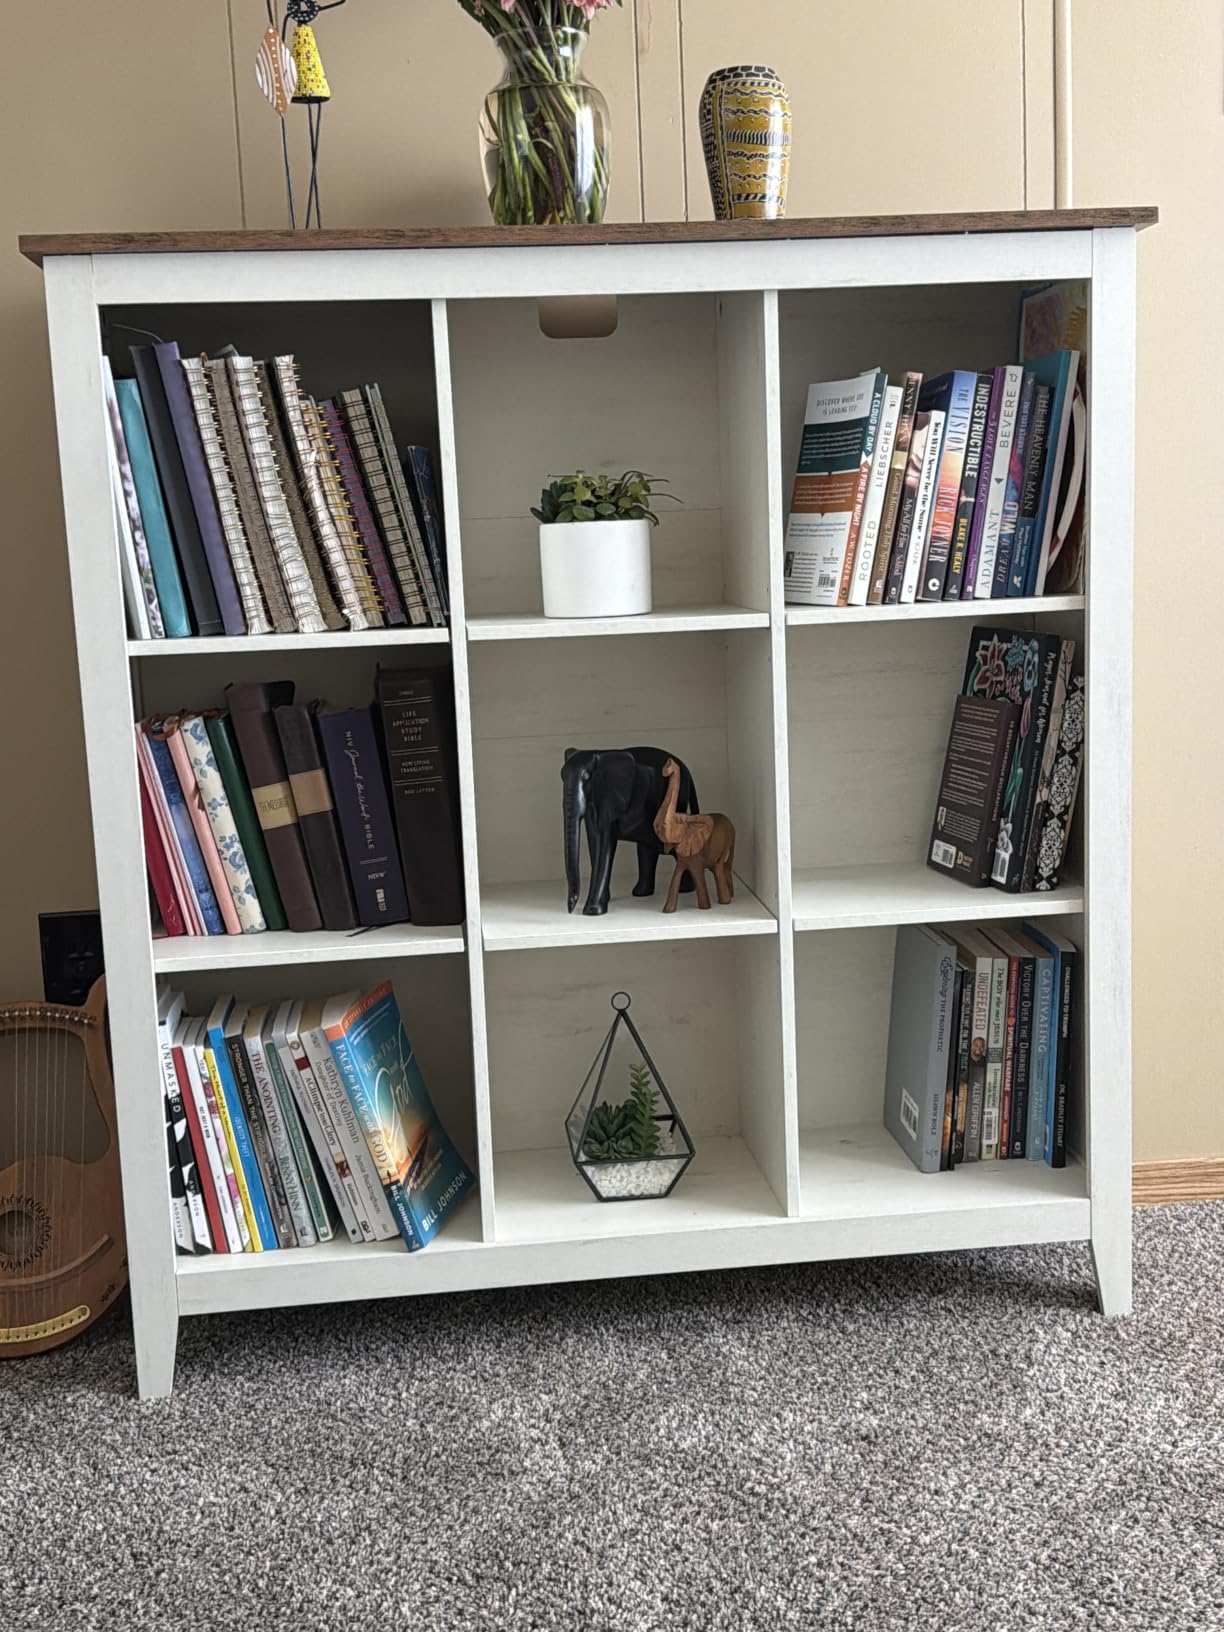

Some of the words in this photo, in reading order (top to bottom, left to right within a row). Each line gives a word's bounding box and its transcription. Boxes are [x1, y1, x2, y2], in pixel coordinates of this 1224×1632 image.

[957, 388, 969, 402] THE
[1037, 394, 1050, 416] THE
[869, 399, 881, 425] CLOUD
[999, 390, 1017, 448] BEVERE
[865, 436, 874, 452] DAY
[867, 425, 876, 436] BY
[933, 421, 942, 437] You
[945, 406, 970, 454] VISION
[965, 383, 990, 478] INDESTRUCTIBLE
[985, 428, 995, 450] LOVE
[875, 421, 893, 488] LIEBSCHER
[930, 437, 939, 456] Will
[1028, 419, 1047, 477] HEAVENLY
[858, 473, 868, 491] FIRE
[926, 457, 935, 480] Never
[978, 453, 992, 503] LANGUAGES
[856, 491, 865, 501] BY
[921, 490, 929, 508] the
[923, 481, 931, 490] be
[935, 487, 957, 513] RICK
[1024, 481, 1036, 510] MAN
[852, 501, 863, 526] NIGHT
[902, 512, 912, 524] All
[904, 499, 913, 512] My
[917, 510, 926, 532] Same
[999, 501, 1019, 535] WILD
[897, 533, 908, 548] Him
[928, 520, 954, 562] JOYNER
[956, 518, 968, 541] BLAKE
[859, 520, 876, 581] ROOTED
[952, 551, 963, 574] HEALY
[980, 509, 1000, 589] ADAMANT
[996, 538, 1010, 583] DREAM
[392, 718, 429, 727] APPLICATION
[402, 710, 416, 718] LIFE
[401, 727, 422, 735] STUDY
[1001, 729, 1013, 776] BREAKTHROUGH
[991, 777, 1004, 821] DECLARATIONS
[364, 823, 375, 850] BIBLE
[1022, 964, 1033, 998] VICTORY
[1063, 966, 1072, 1004] CHALLENGED
[939, 1000, 948, 1013] THE
[974, 972, 990, 1031] UNDEFEATED
[1021, 1000, 1032, 1021] OVER
[1038, 967, 1051, 1053] CAPTIVATING
[937, 1014, 946, 1053] PROPHETIC
[992, 1021, 1001, 1045] JESUS
[1005, 1026, 1014, 1059] SPIRITUAL
[1020, 1024, 1028, 1038] THE
[161, 1043, 181, 1113] UNMASKED
[1004, 1060, 1012, 1091] WARFARE
[1017, 1041, 1029, 1083] DARKNESS
[231, 1043, 247, 1083] STRONGER
[243, 1084, 253, 1104] THAN
[249, 1105, 257, 1120] THE
[253, 1121, 268, 1159] STRUGGLE
[252, 1050, 264, 1073] THE
[259, 1076, 280, 1134] ANOINTING
[315, 1061, 331, 1090] Daughter
[326, 1091, 333, 1101] of
[330, 1101, 343, 1127] Destiny
[323, 1058, 343, 1097] Kathryn
[339, 1098, 359, 1144] Kuhlman
[336, 1044, 353, 1074] FACE
[348, 1074, 356, 1083] to
[352, 1085, 368, 1113] FACE
[364, 1115, 378, 1133] with
[371, 1135, 388, 1163] GOD
[972, 1081, 981, 1104] ALLEN
[307, 1082, 321, 1112] Glimpse
[324, 1124, 337, 1147] Glory
[969, 1104, 980, 1138] GRIFFIN
[280, 1156, 296, 1187] BENNY
[288, 1185, 302, 1211] HINN
[356, 1154, 366, 1174] Jamie
[362, 1173, 381, 1215] Buckingham
[390, 1185, 399, 1201] BILL
[397, 1202, 413, 1236] JOHNSON
[421, 1209, 439, 1232] BILL
[438, 1171, 467, 1212] JOHNSON
[173, 1202, 183, 1239] ANDERSON
